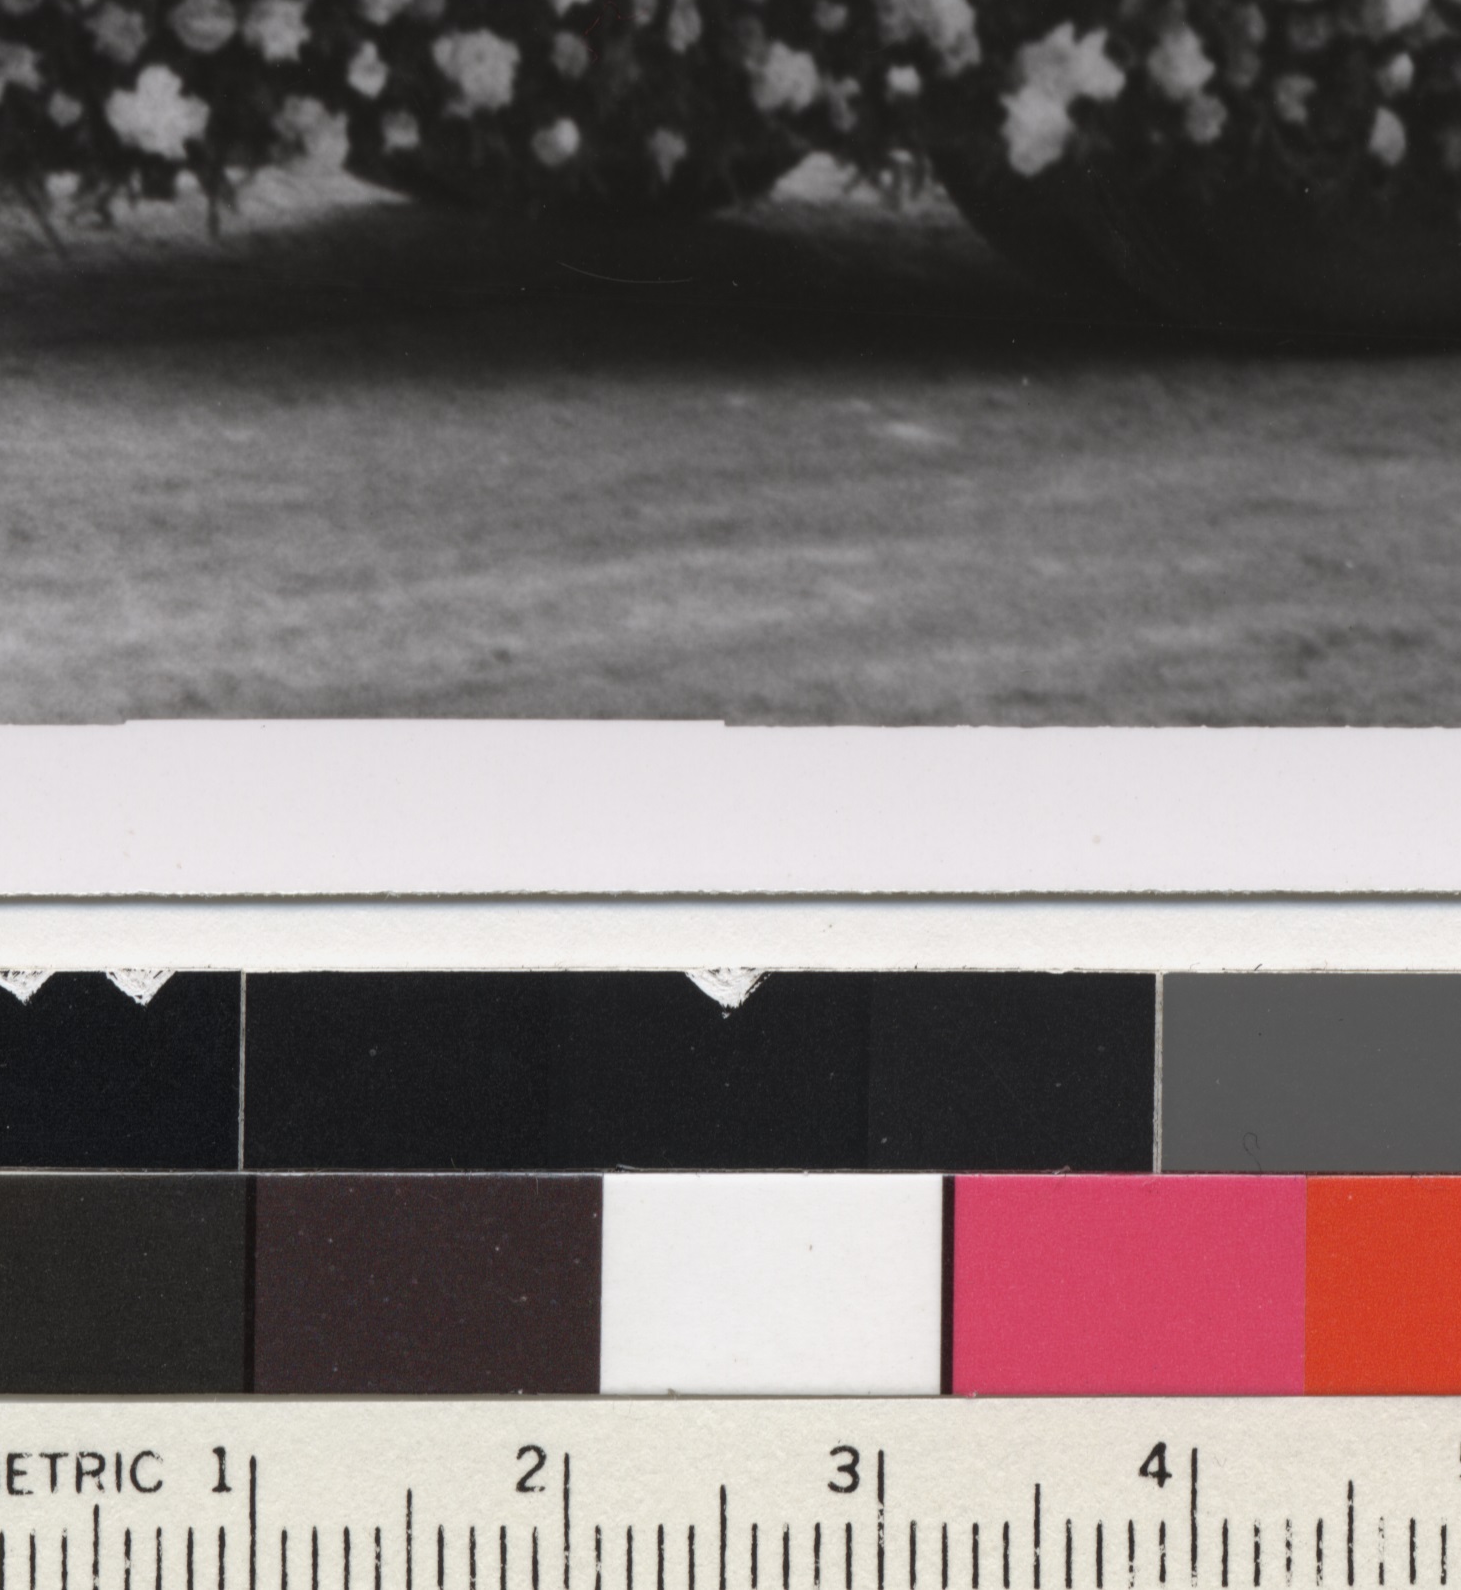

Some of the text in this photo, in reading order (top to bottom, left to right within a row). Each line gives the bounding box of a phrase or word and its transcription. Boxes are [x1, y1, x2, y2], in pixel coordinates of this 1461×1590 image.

[210, 1446, 233, 1494] 1
[515, 1444, 548, 1494] 2
[827, 1444, 862, 1494] 3
[1138, 1441, 1174, 1489] 4
